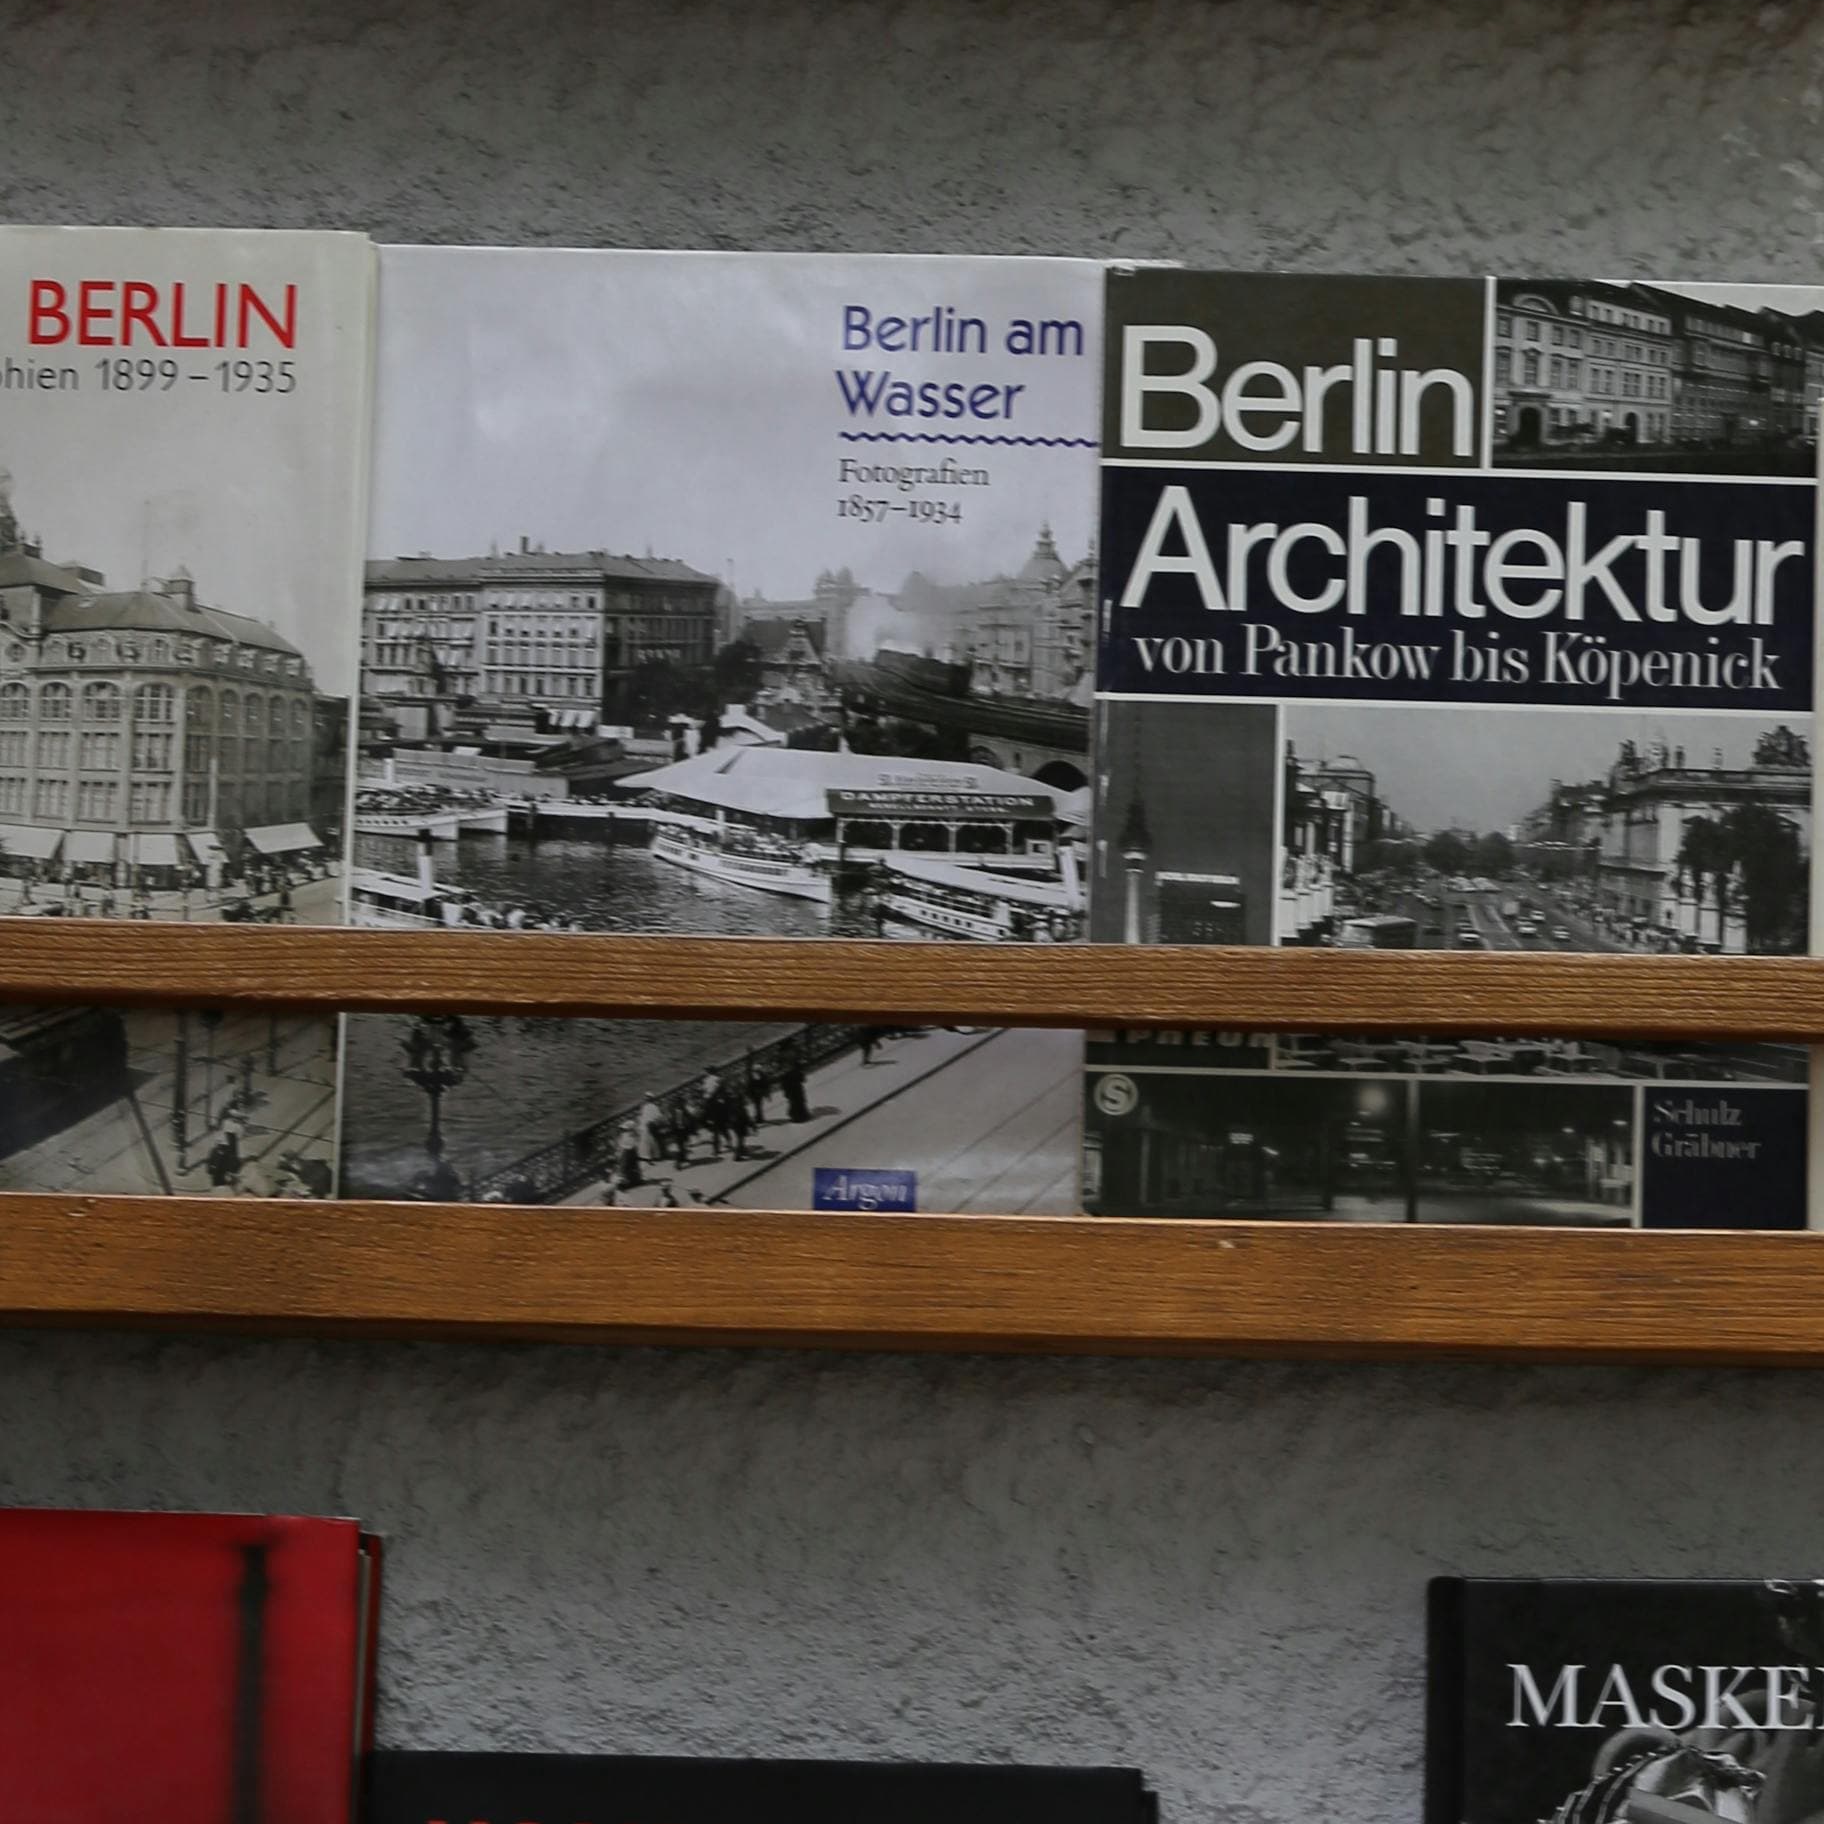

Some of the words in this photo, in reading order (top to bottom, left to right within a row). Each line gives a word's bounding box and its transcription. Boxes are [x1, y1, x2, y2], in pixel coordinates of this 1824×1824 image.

[28, 279, 297, 348] BERLIN
[843, 305, 987, 357] Berlin
[1005, 320, 1083, 358] am
[837, 369, 1023, 420] Wasser
[1120, 324, 1473, 457] Berlin
[839, 459, 990, 494] Fotografien
[1120, 484, 1805, 627] Architektur
[1135, 635, 1225, 676] von
[1239, 623, 1438, 683] Pankow
[1454, 629, 1528, 685] bis
[1542, 632, 1782, 699] Köpenick
[1654, 1100, 1742, 1128] Schulz
[823, 1178, 908, 1210] Argon
